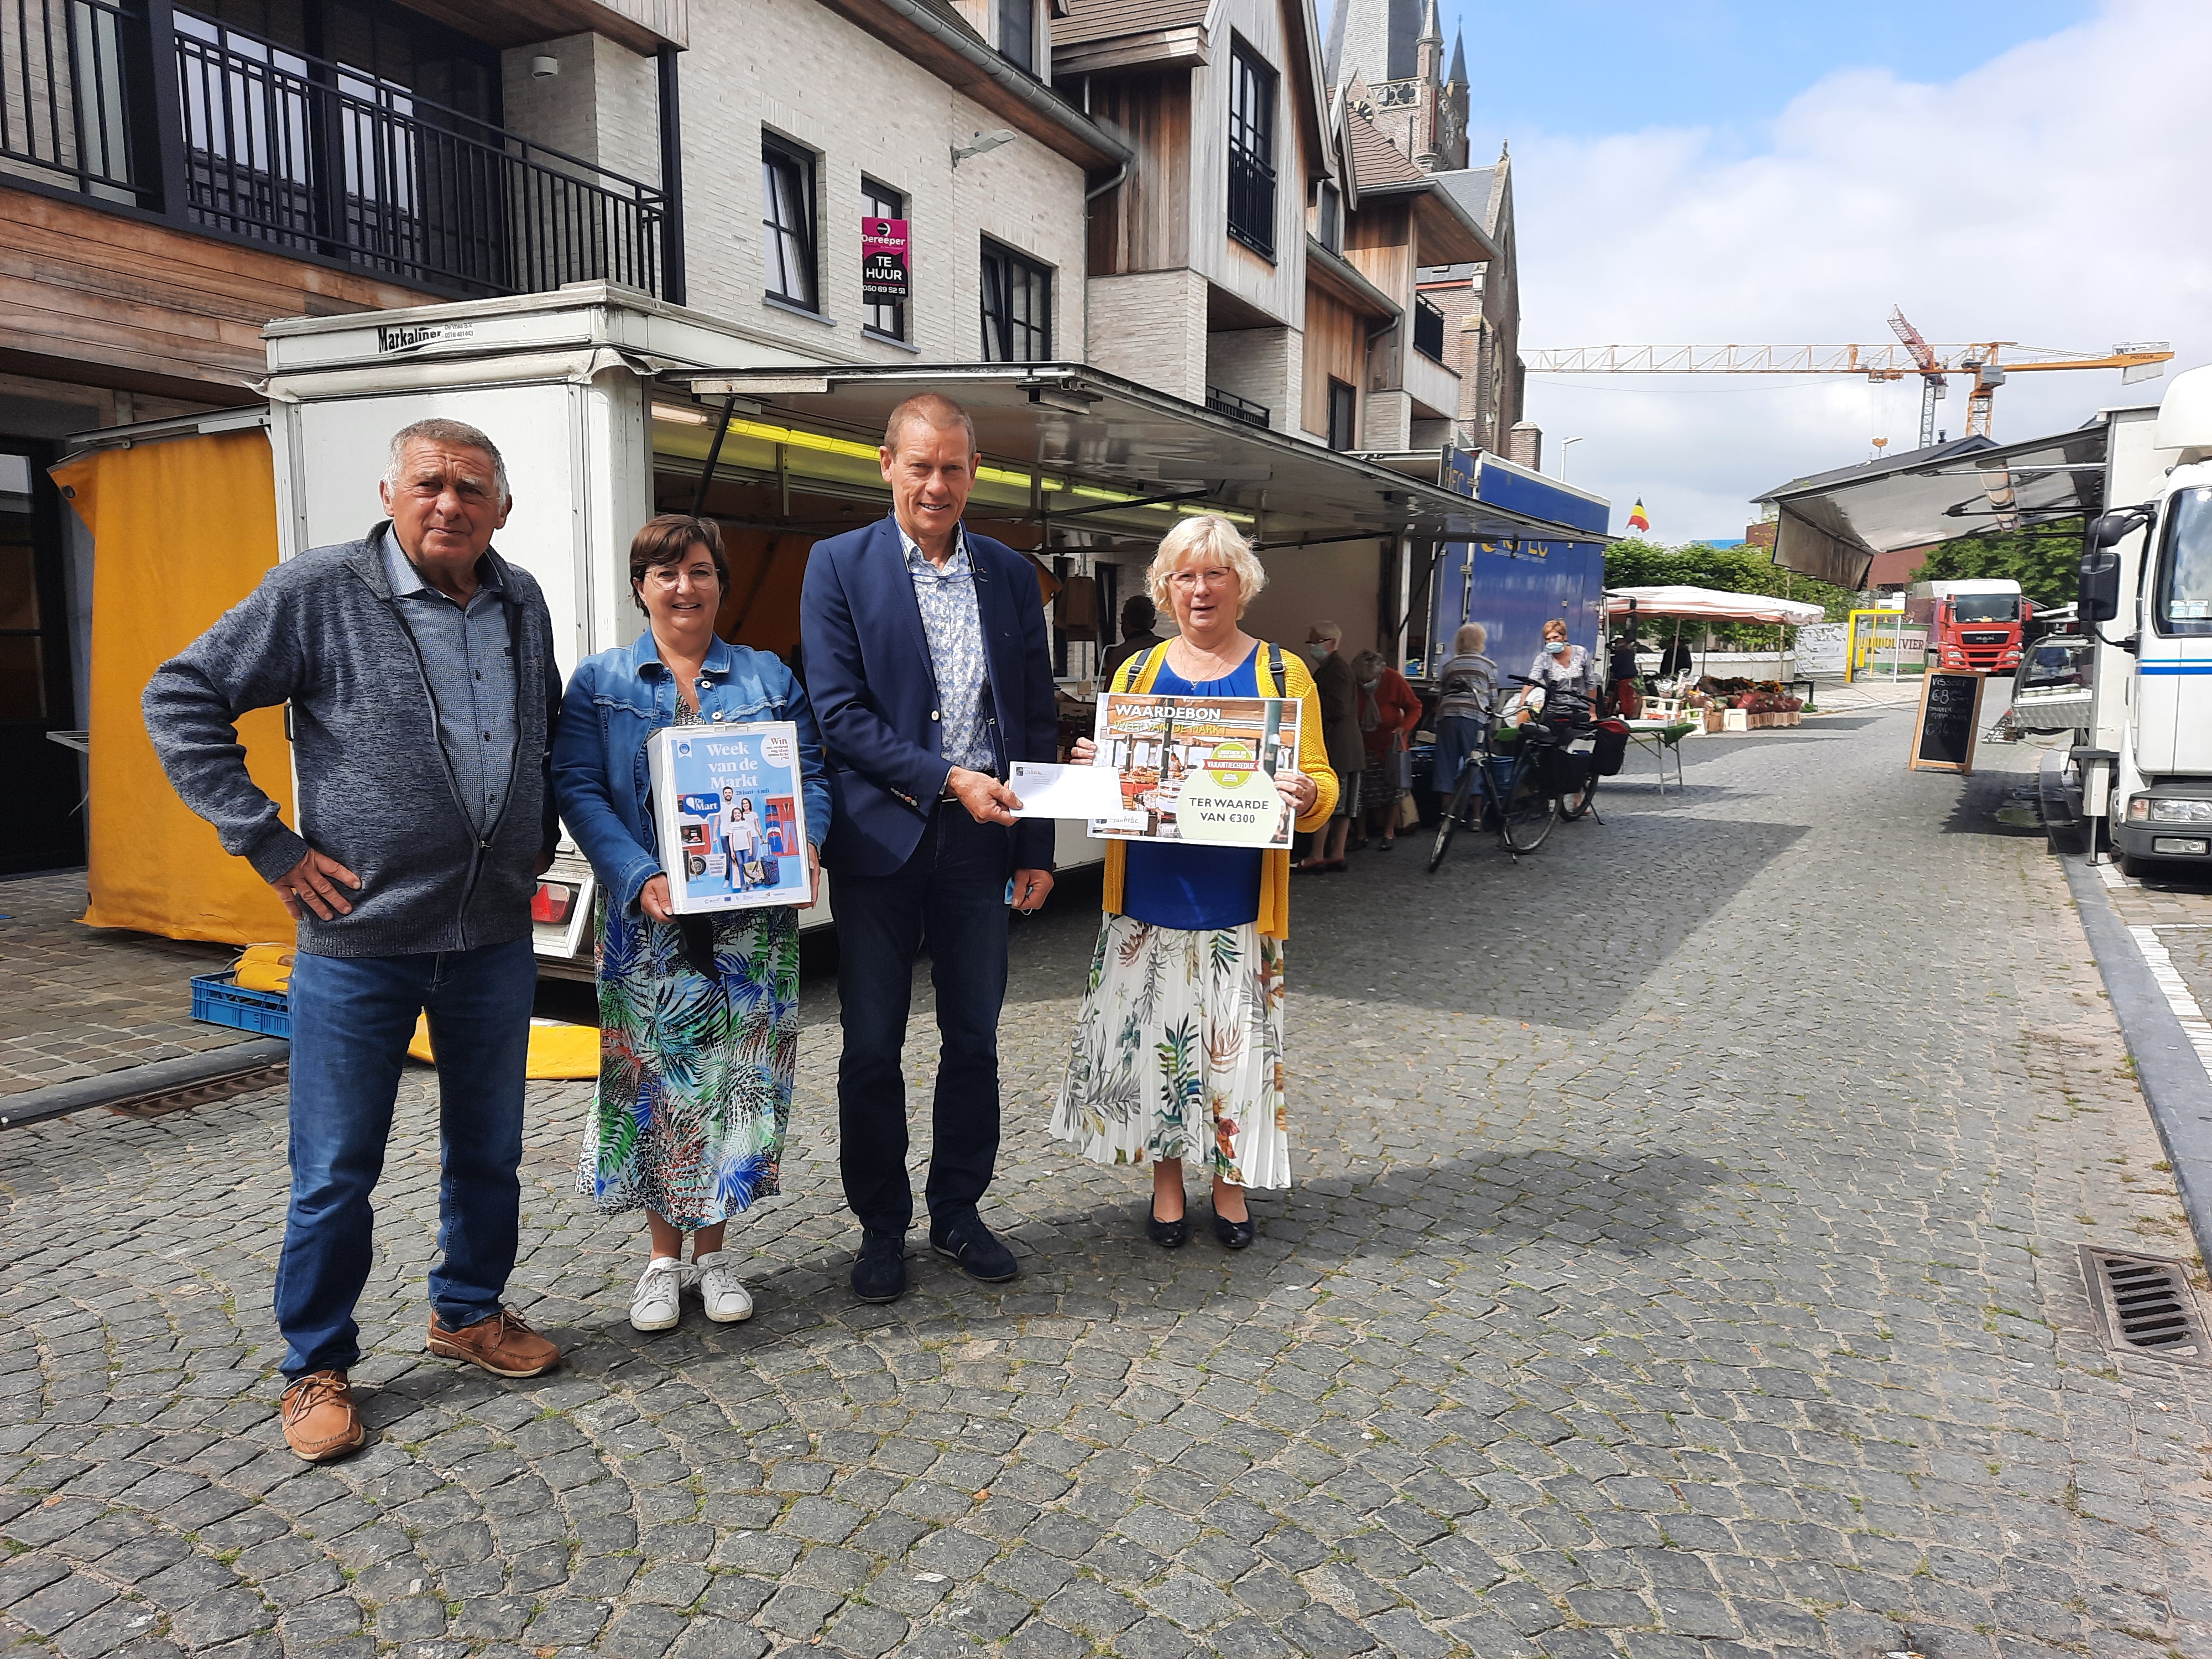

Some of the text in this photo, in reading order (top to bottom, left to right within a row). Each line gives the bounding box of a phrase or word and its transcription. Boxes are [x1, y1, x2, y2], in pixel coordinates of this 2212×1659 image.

[875, 256, 891, 267] TE
[866, 268, 902, 280] HUUR
[377, 327, 441, 353] Markaliner
[1115, 704, 1221, 720] WAARDEBON
[1114, 721, 1227, 735] WEEK VAN DE MARKT
[706, 741, 750, 757] Week
[707, 757, 758, 773] van de
[1207, 761, 1255, 769] VAKANTIECHEQUE
[709, 774, 759, 790] Markt
[695, 802, 718, 811] Mart
[1189, 798, 1269, 810] TER WAARDE
[1200, 812, 1255, 823] VAN €300
